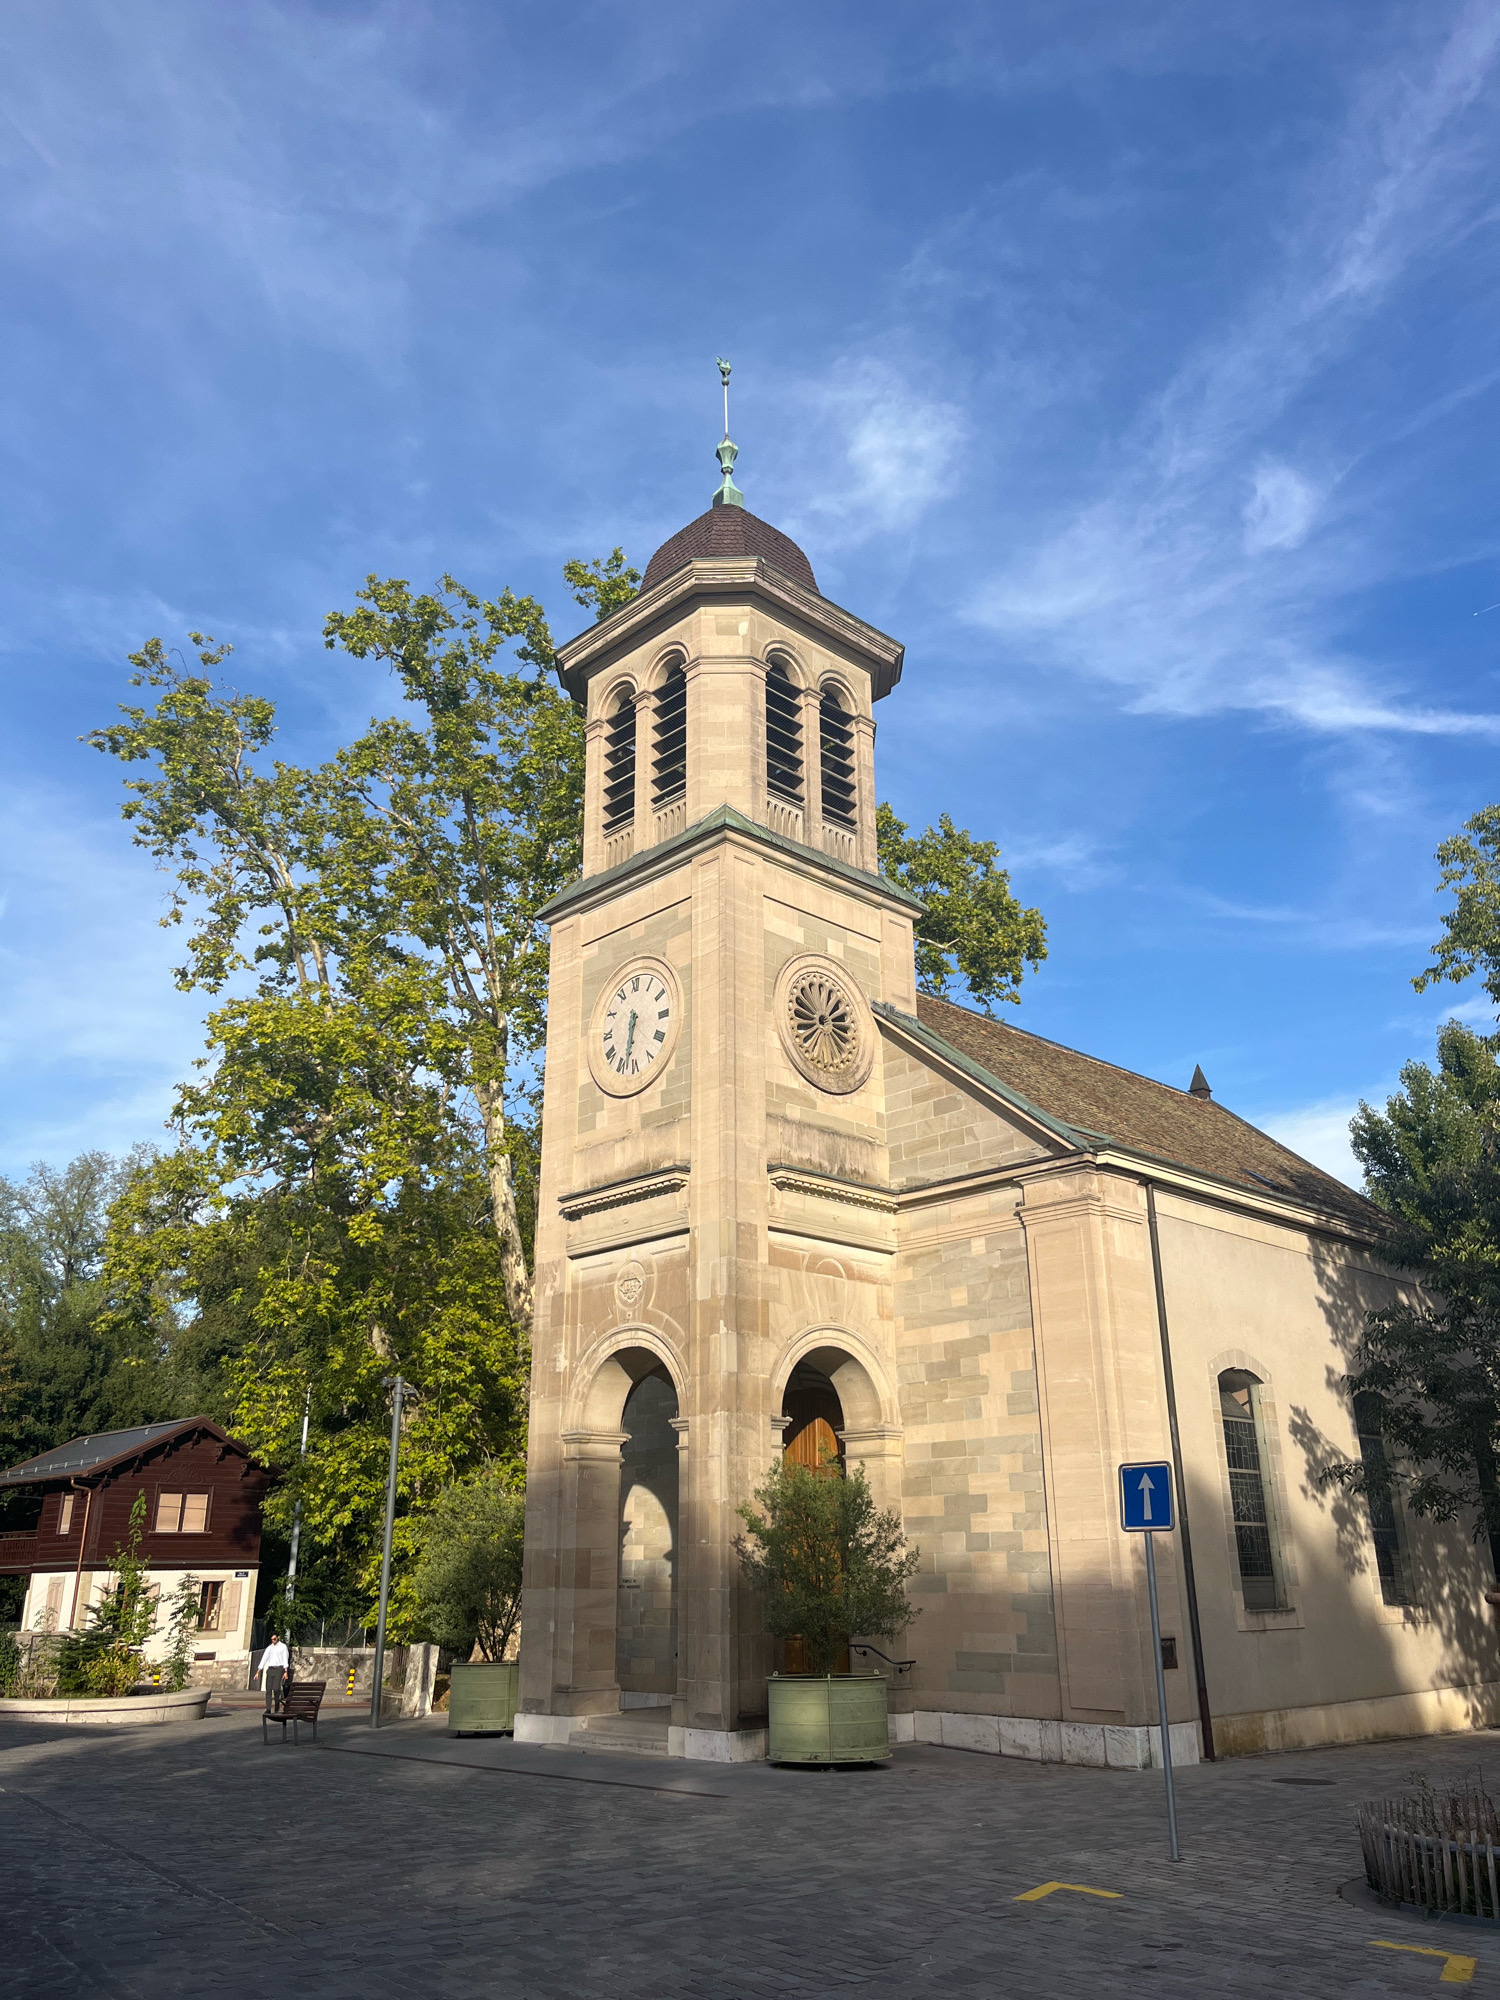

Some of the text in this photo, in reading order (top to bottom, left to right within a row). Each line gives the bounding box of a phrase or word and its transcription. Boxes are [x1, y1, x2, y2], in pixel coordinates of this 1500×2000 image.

[646, 977, 653, 992] I
[607, 1010, 617, 1019] X
[646, 1050, 654, 1063] V
